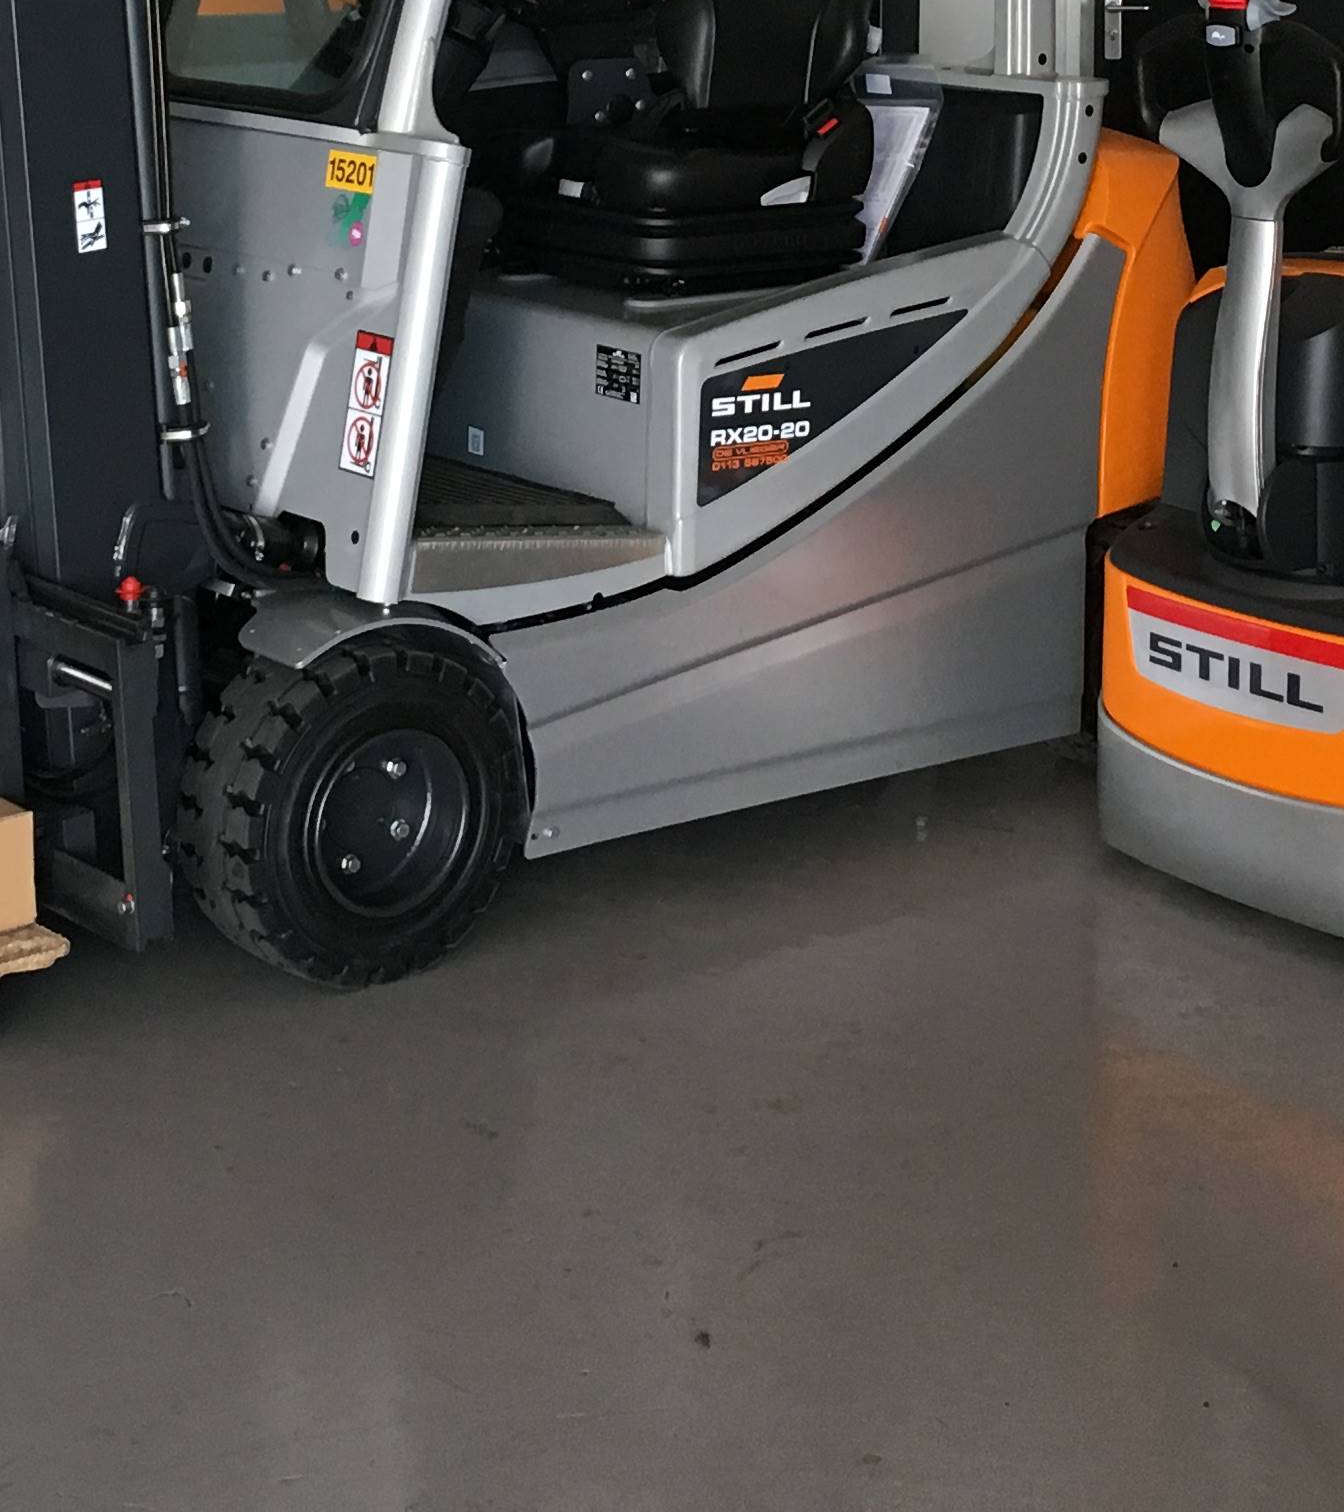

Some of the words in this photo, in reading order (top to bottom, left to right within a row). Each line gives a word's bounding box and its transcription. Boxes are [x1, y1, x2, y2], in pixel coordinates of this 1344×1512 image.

[329, 156, 375, 188] 15201
[711, 389, 811, 417] STILL
[710, 420, 810, 447] RX20-20
[1149, 631, 1324, 713] STILL
